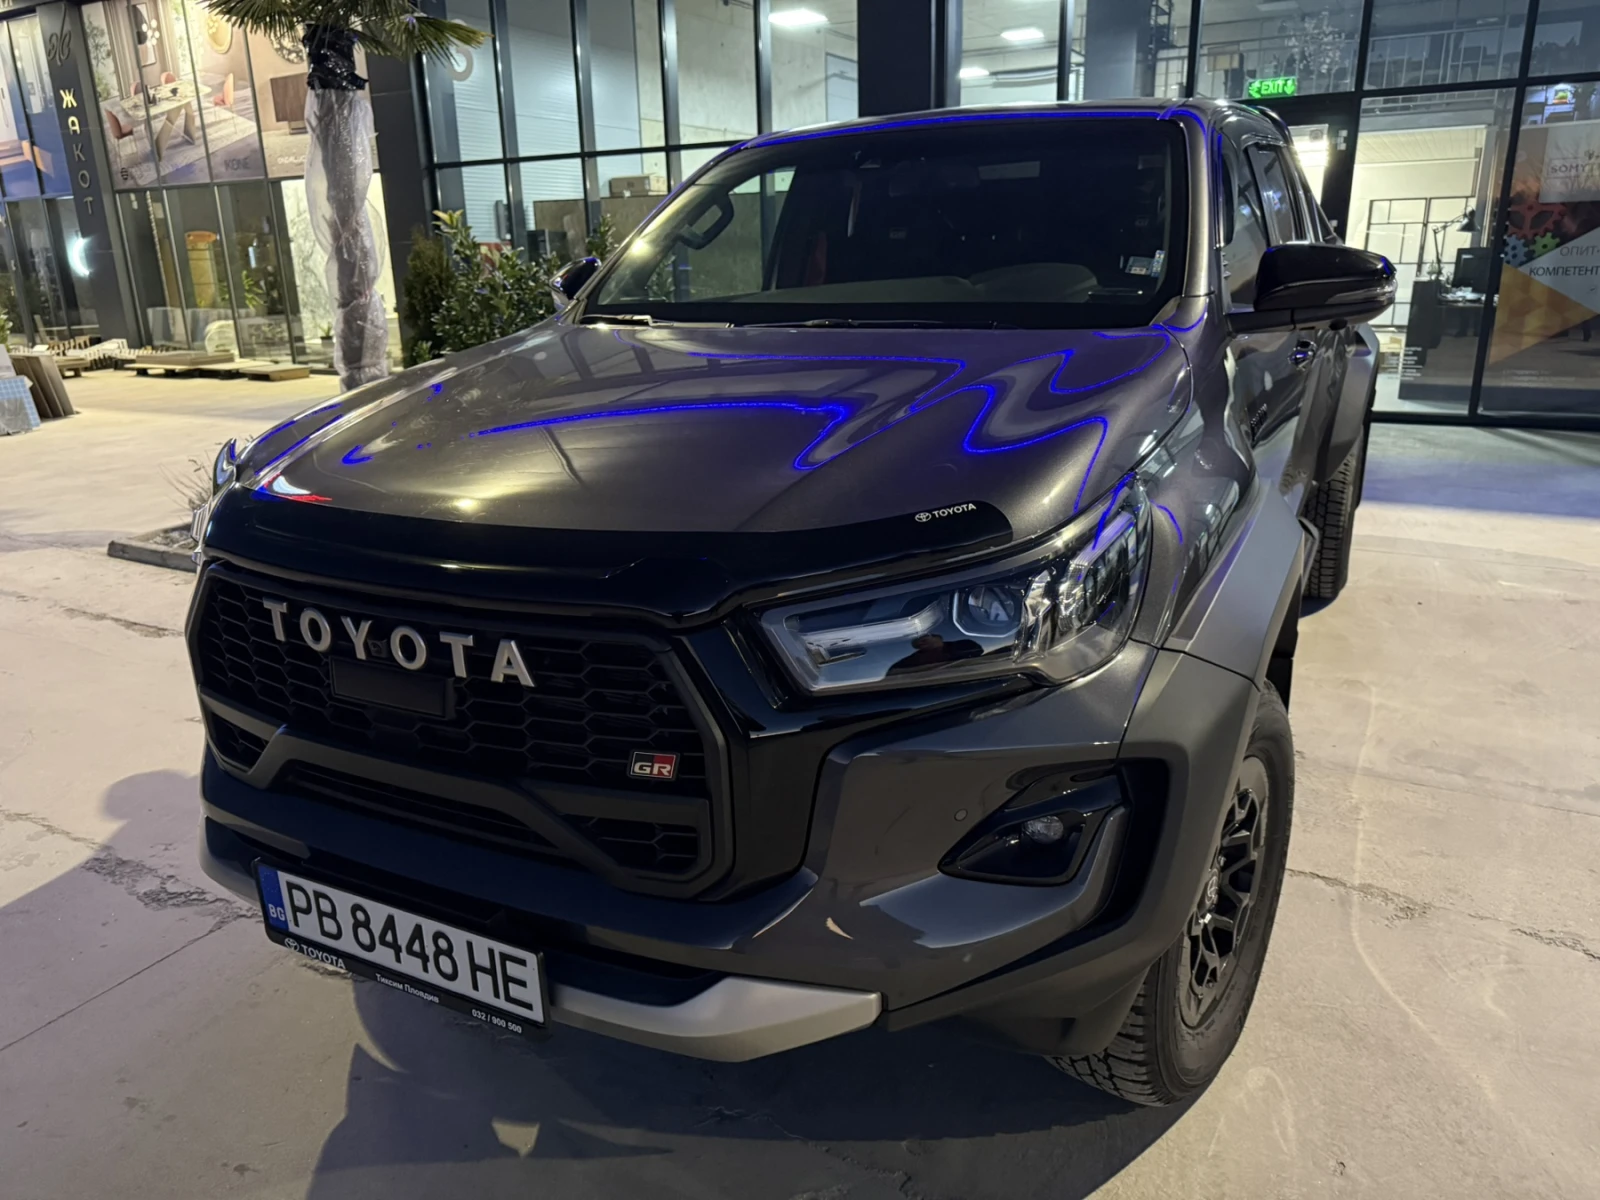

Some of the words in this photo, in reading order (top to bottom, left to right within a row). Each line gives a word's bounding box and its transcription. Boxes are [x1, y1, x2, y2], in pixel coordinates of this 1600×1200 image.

[1261, 79, 1285, 95] EXIT
[59, 88, 94, 215] ЖАКОТ
[1529, 265, 1600, 277] КОМПЕТЕНТ
[932, 503, 976, 518] TOYOTA
[262, 597, 536, 688] TOYOTA
[633, 761, 672, 776] GR
[268, 903, 286, 921] BG
[285, 880, 343, 941] PB
[350, 903, 459, 982] 8448
[466, 940, 534, 1011] HE
[301, 944, 345, 969] TOYOTA
[404, 983, 440, 1003] Пловдив
[471, 1009, 486, 1021] 032
[507, 1020, 523, 1034] 500
